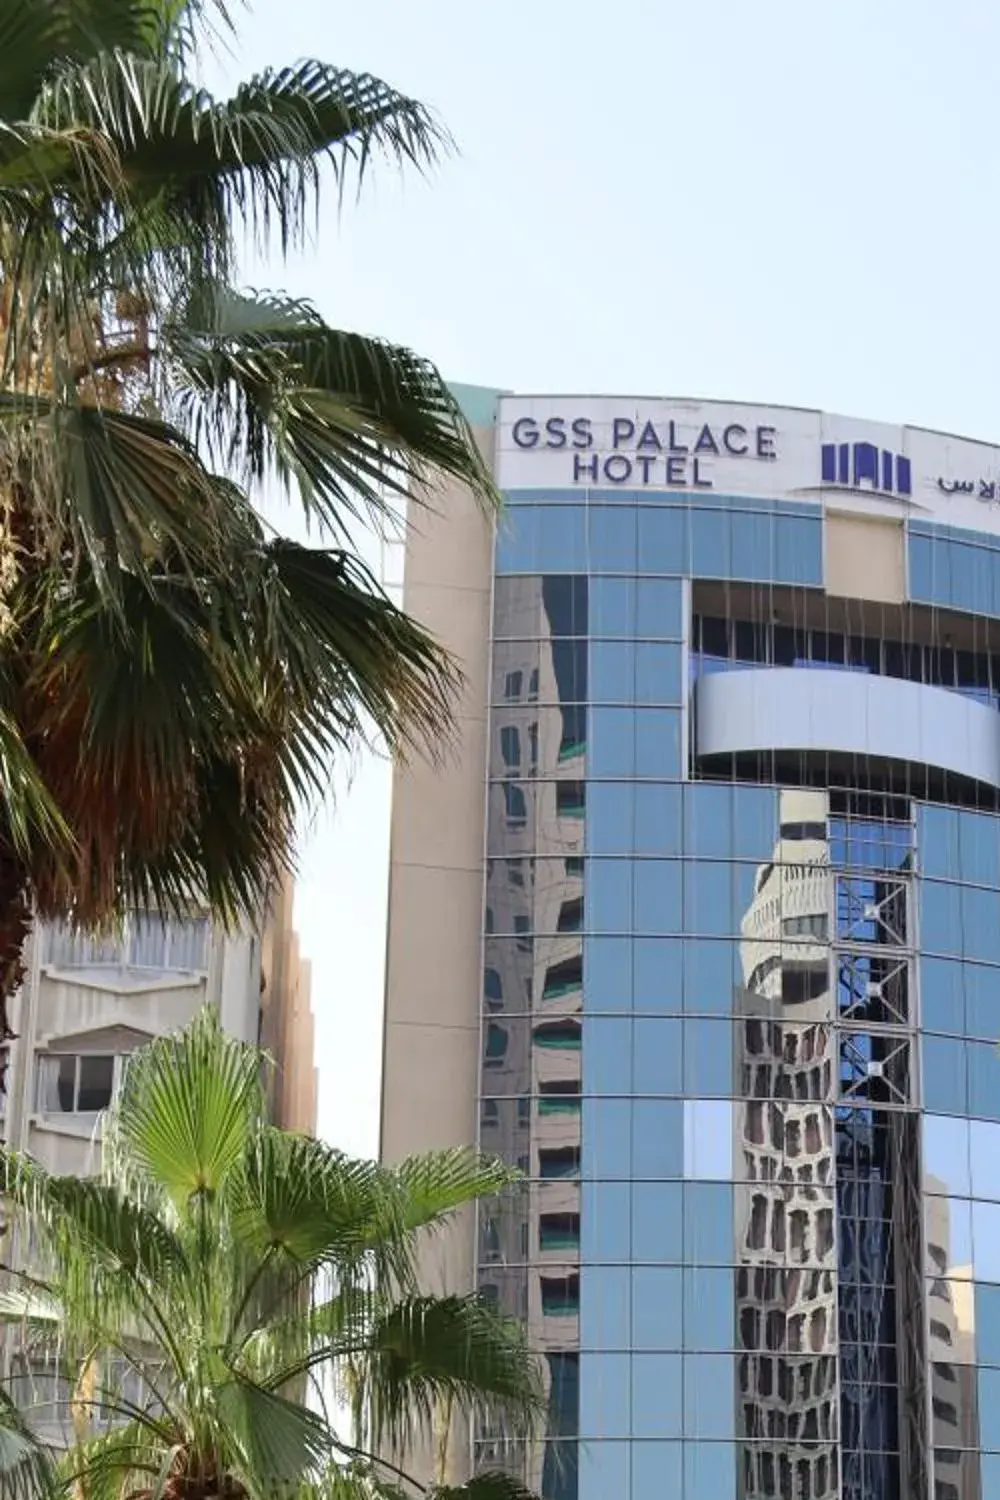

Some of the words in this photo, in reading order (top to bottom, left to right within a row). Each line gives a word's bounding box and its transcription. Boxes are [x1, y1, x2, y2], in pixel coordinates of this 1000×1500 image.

[512, 417, 593, 449] GSS
[613, 417, 777, 458] PALACE
[573, 453, 712, 486] HOTEL
